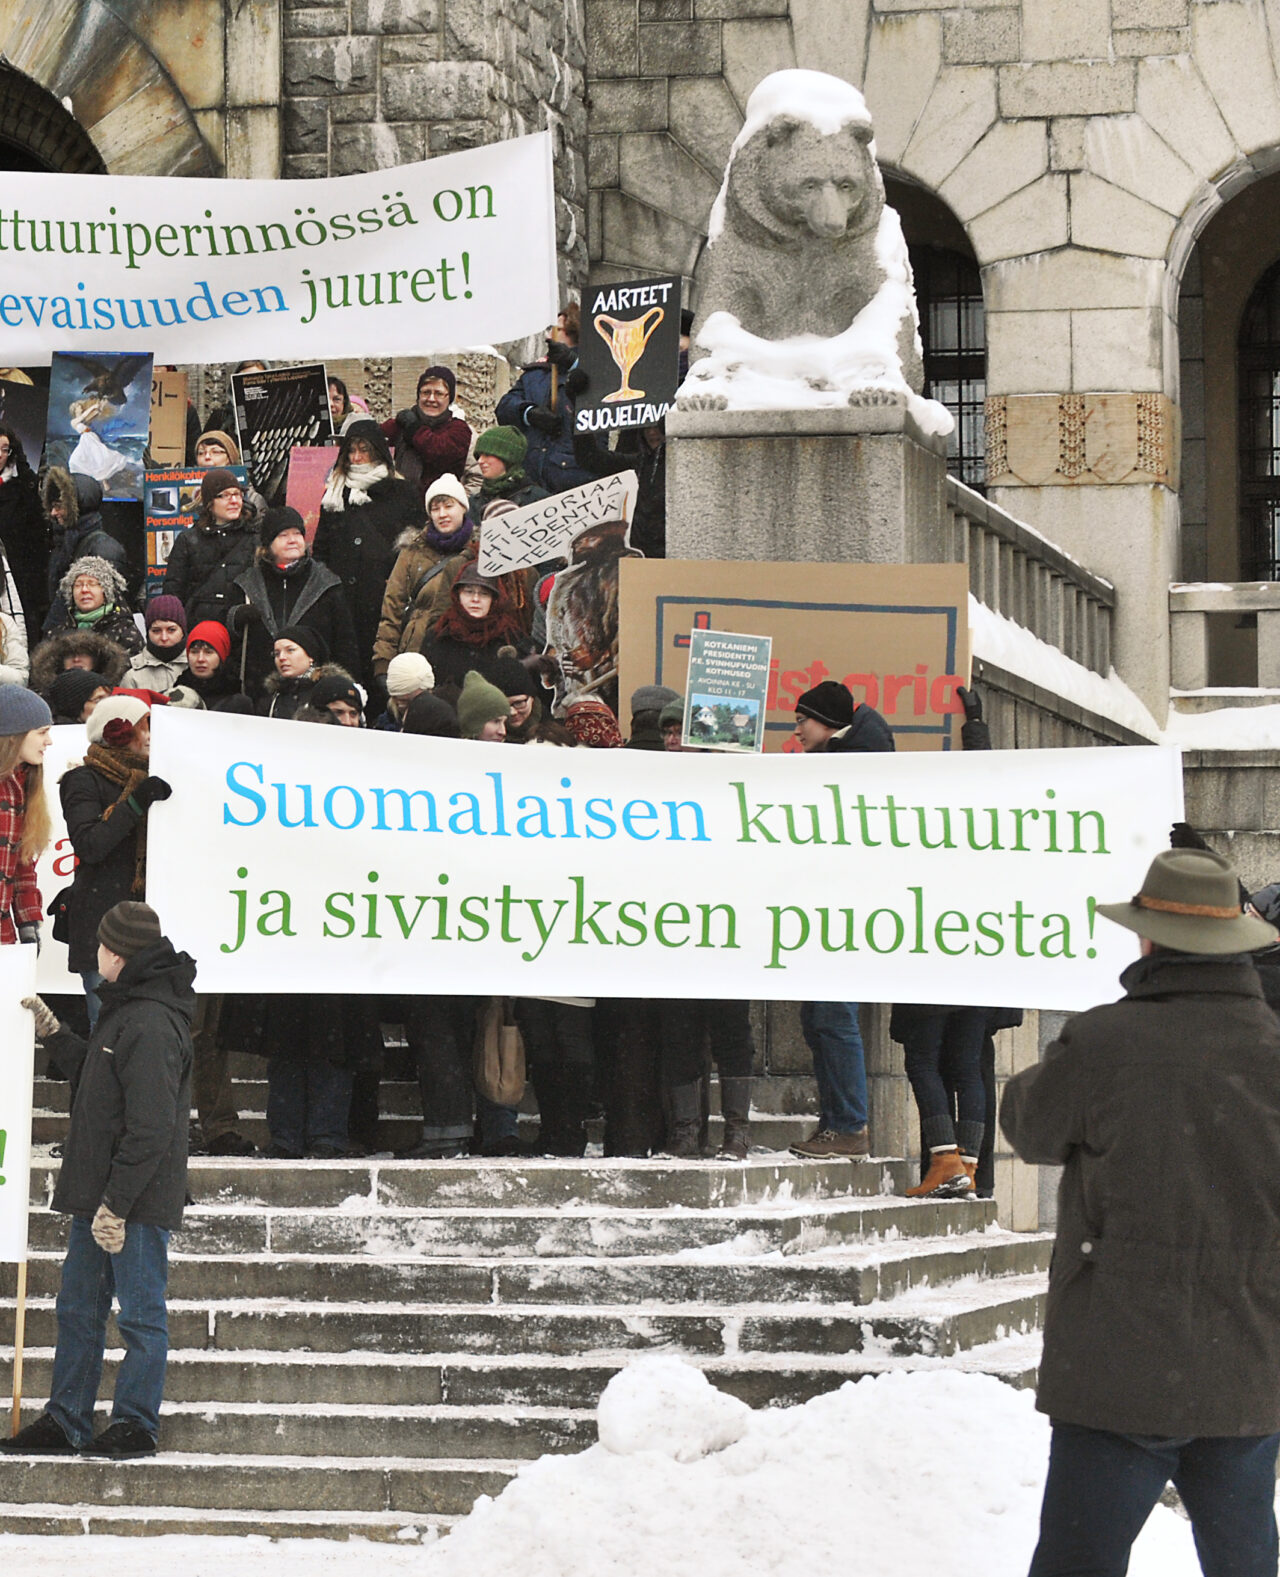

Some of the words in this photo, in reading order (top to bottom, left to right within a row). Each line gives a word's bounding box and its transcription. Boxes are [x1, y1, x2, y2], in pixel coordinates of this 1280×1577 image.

[433, 185, 494, 220] on
[300, 251, 473, 324] juuret!
[591, 282, 674, 314] AARTEET
[145, 470, 208, 482] Henkilökohta
[146, 515, 194, 527] Personligt
[703, 649, 756, 661] PRESIDENTTI
[704, 640, 758, 653] KOTKANIEMI
[705, 668, 752, 678] KOTIMUSEO
[738, 689, 746, 697] 17
[766, 658, 966, 717] istoria
[222, 761, 713, 842] Suomalaisen
[734, 782, 1110, 854] kulttuurin
[220, 866, 297, 953] ja
[323, 871, 740, 962] sivistyksen
[764, 886, 1098, 969] puolesta!
